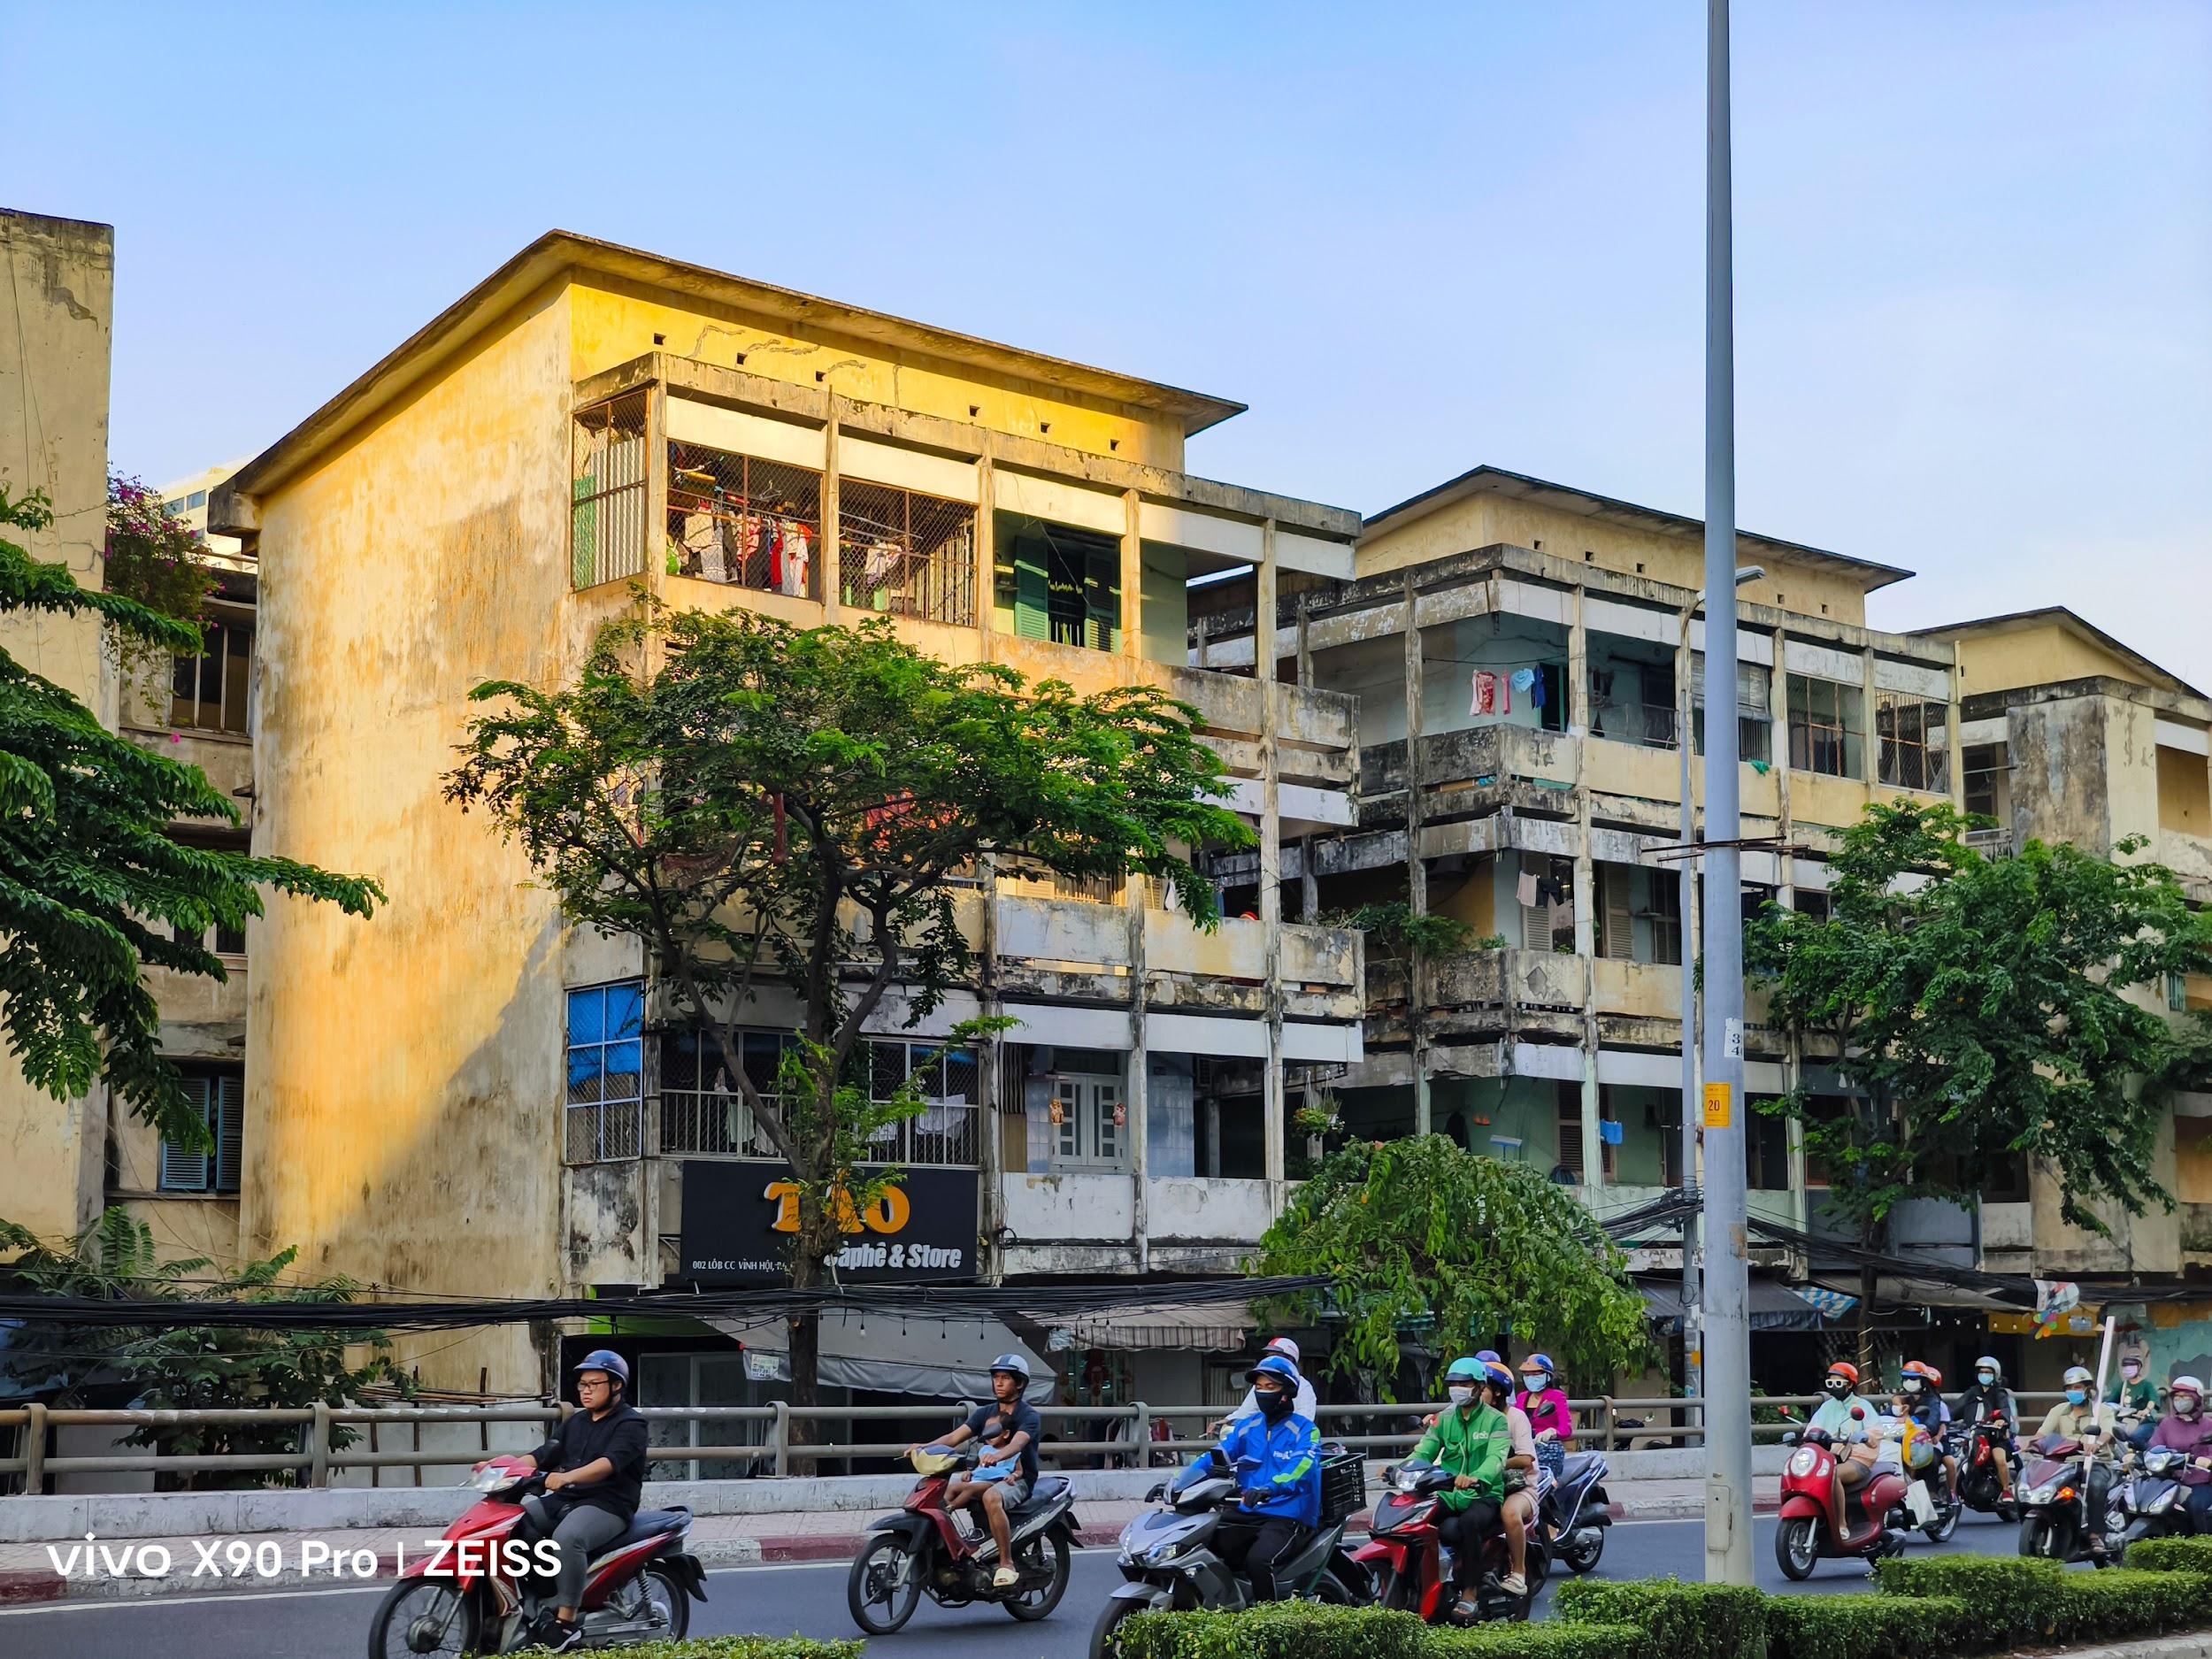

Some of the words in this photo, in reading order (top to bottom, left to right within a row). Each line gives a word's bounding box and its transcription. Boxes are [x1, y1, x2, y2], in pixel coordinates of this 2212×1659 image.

[1708, 1100, 1720, 1111] 20
[887, 1243, 905, 1268] &
[906, 1243, 962, 1268] Store
[692, 1261, 706, 1270] 002
[724, 1261, 735, 1270] CC
